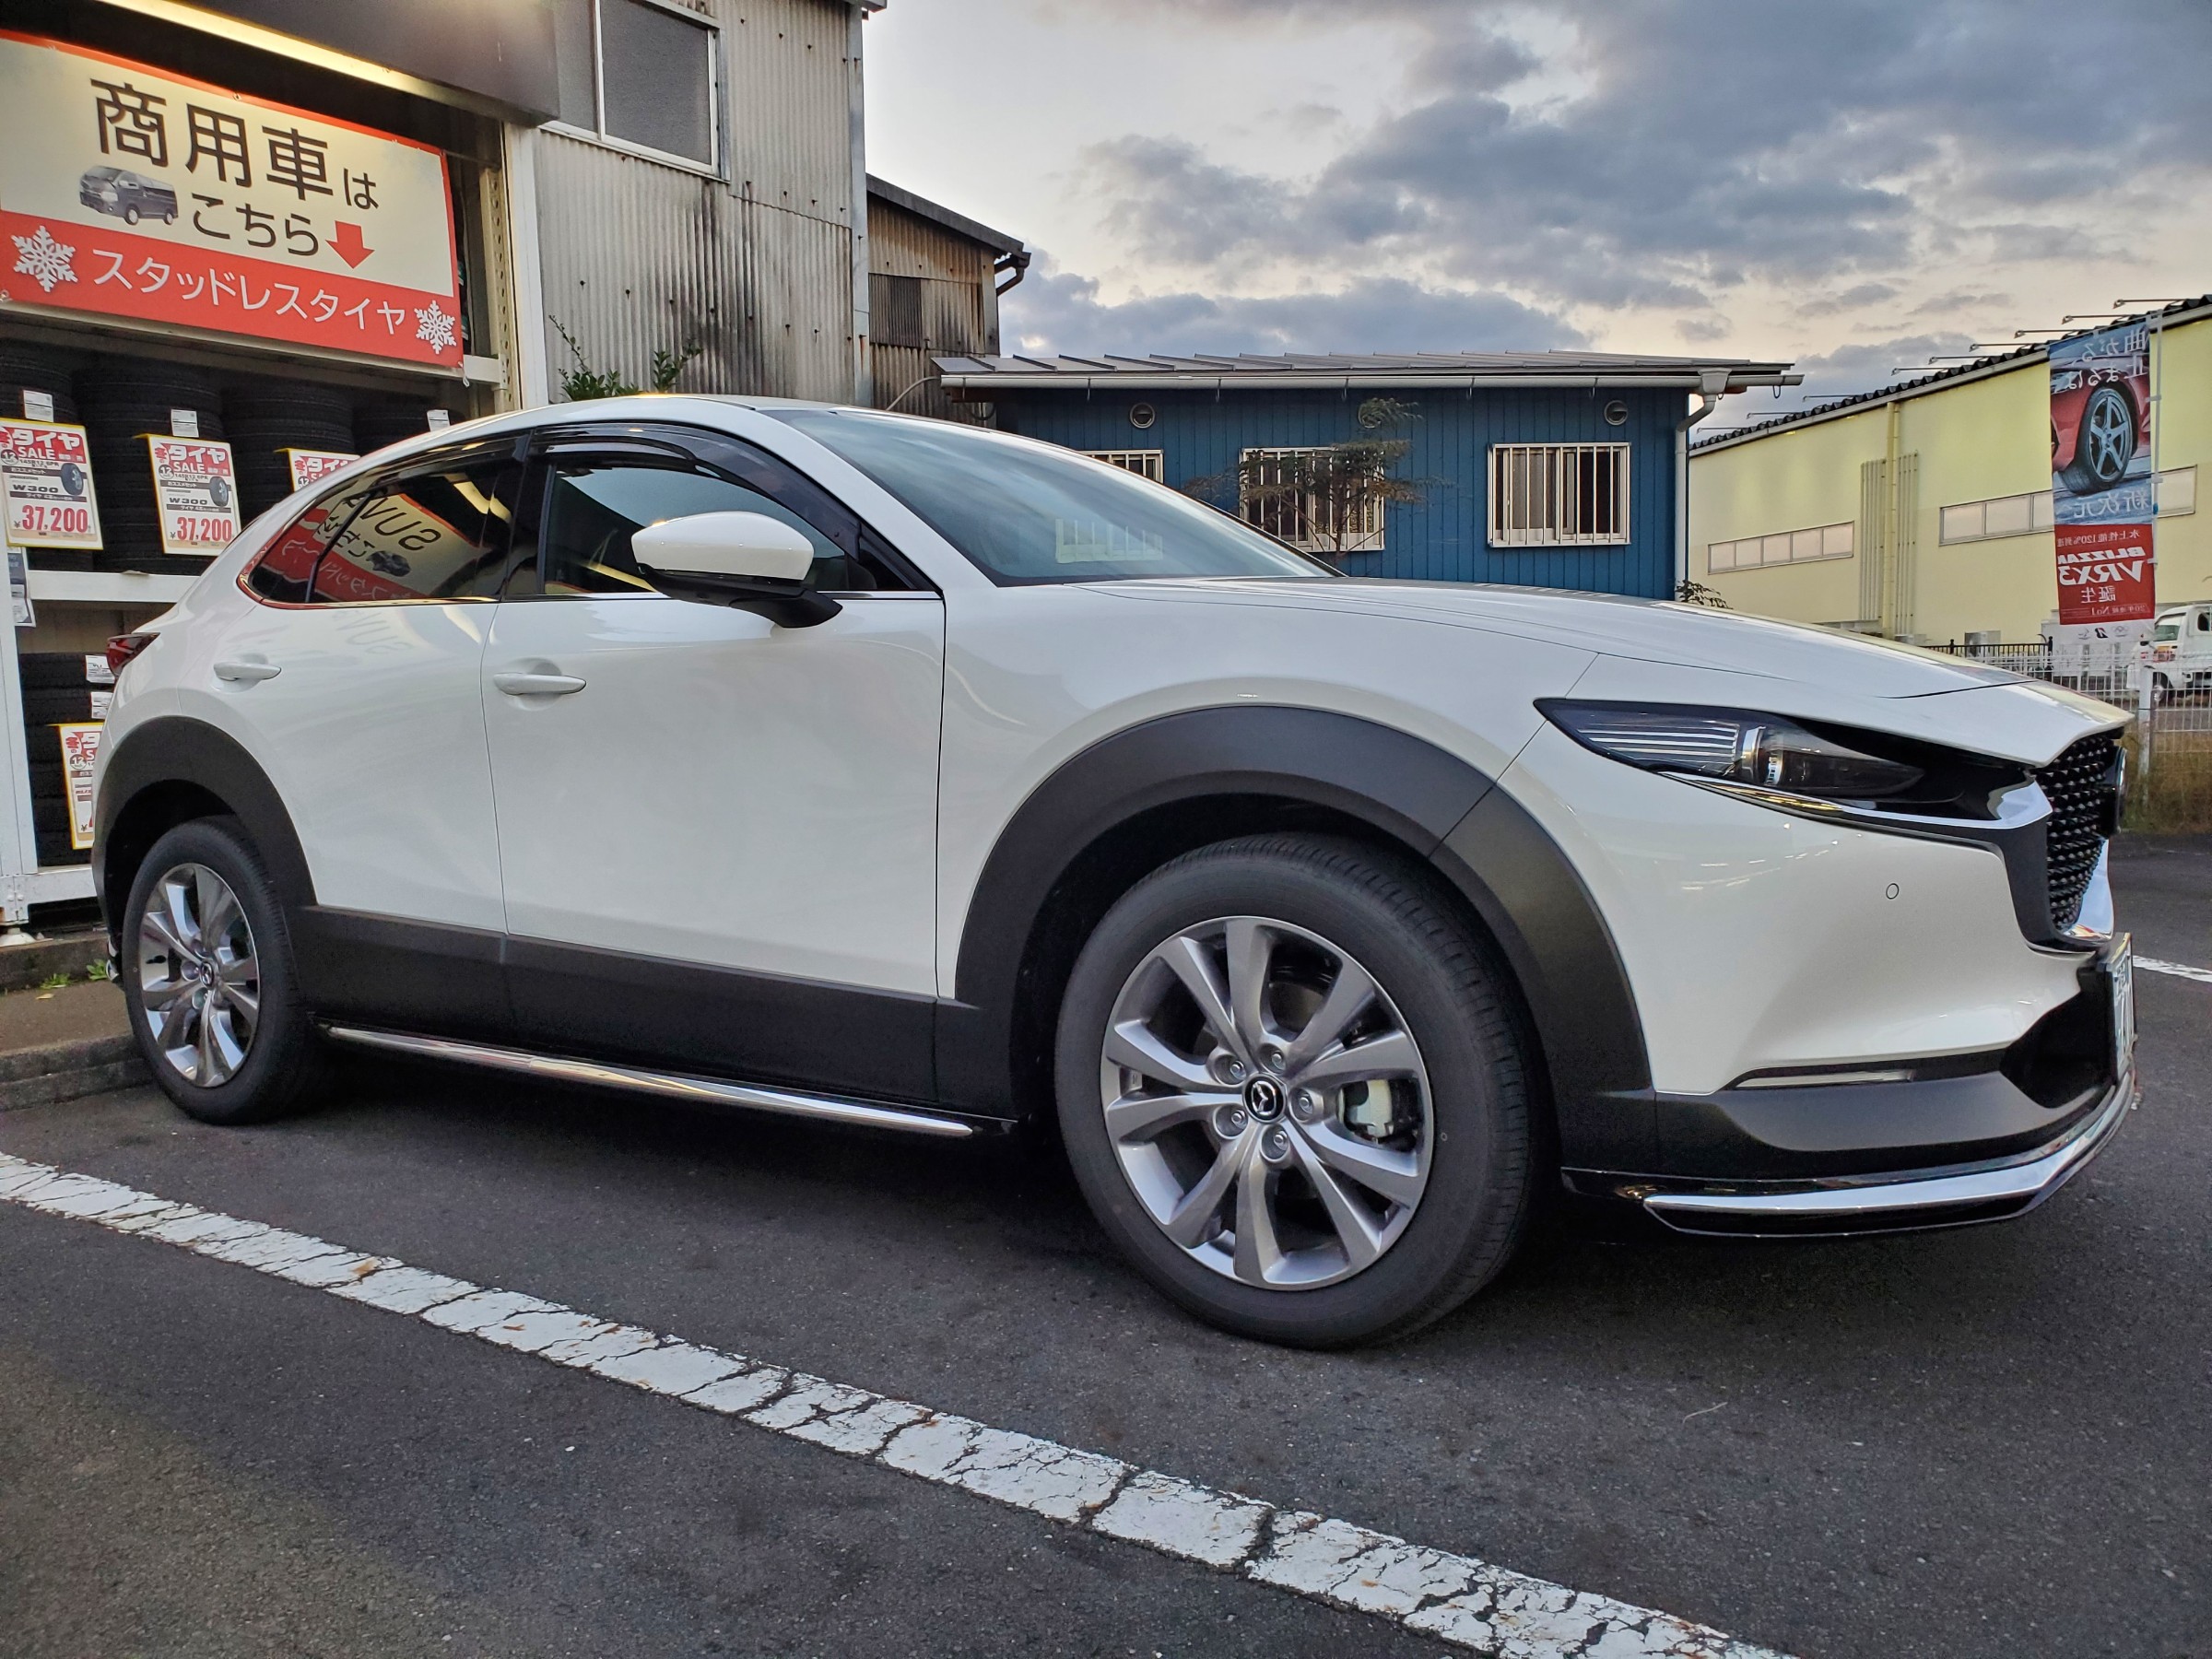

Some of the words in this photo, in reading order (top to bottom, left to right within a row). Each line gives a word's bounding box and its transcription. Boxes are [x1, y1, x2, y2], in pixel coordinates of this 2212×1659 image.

[89, 77, 380, 211] 商用車は
[190, 192, 320, 257] こちら
[92, 248, 406, 335] スタッドレスタイヤ
[12, 429, 80, 451] タイヤ
[18, 447, 55, 460] SALE
[169, 445, 225, 464] タイヤ
[173, 462, 206, 473] SALE
[13, 484, 59, 493] W300
[169, 497, 208, 506] W300
